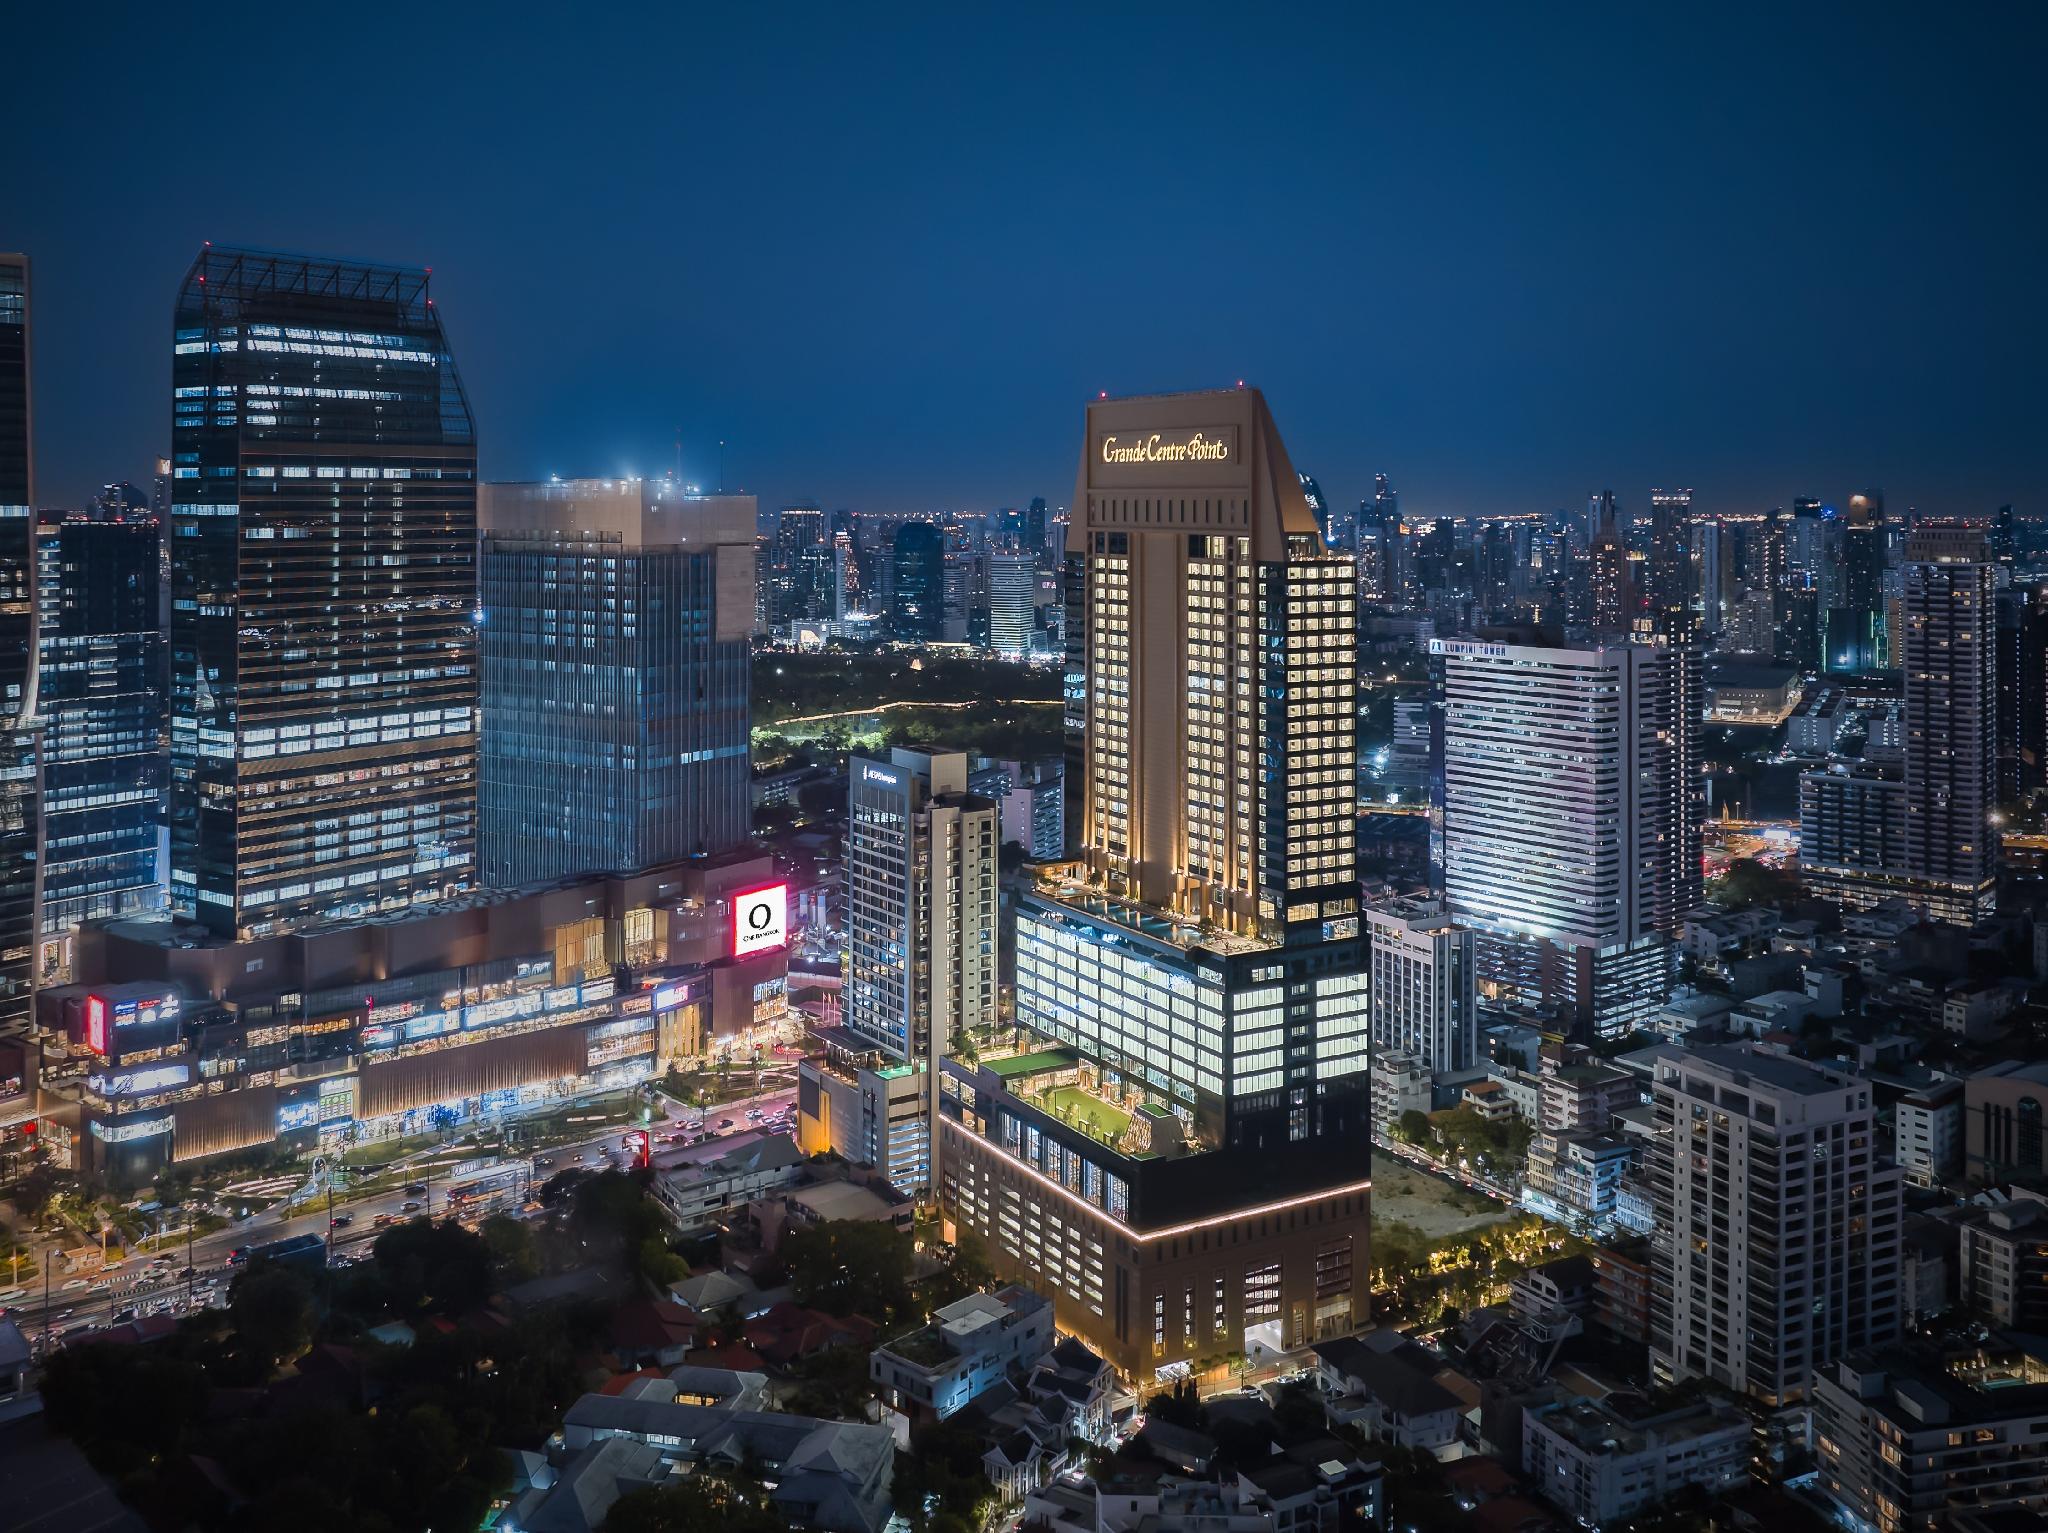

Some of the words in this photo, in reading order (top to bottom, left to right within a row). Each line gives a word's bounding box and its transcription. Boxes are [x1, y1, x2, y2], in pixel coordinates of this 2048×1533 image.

[1103, 437, 1147, 463] Grande
[1147, 435, 1187, 462] Centre
[1187, 432, 1228, 461] Point
[1445, 643, 1476, 654] LUMPINI
